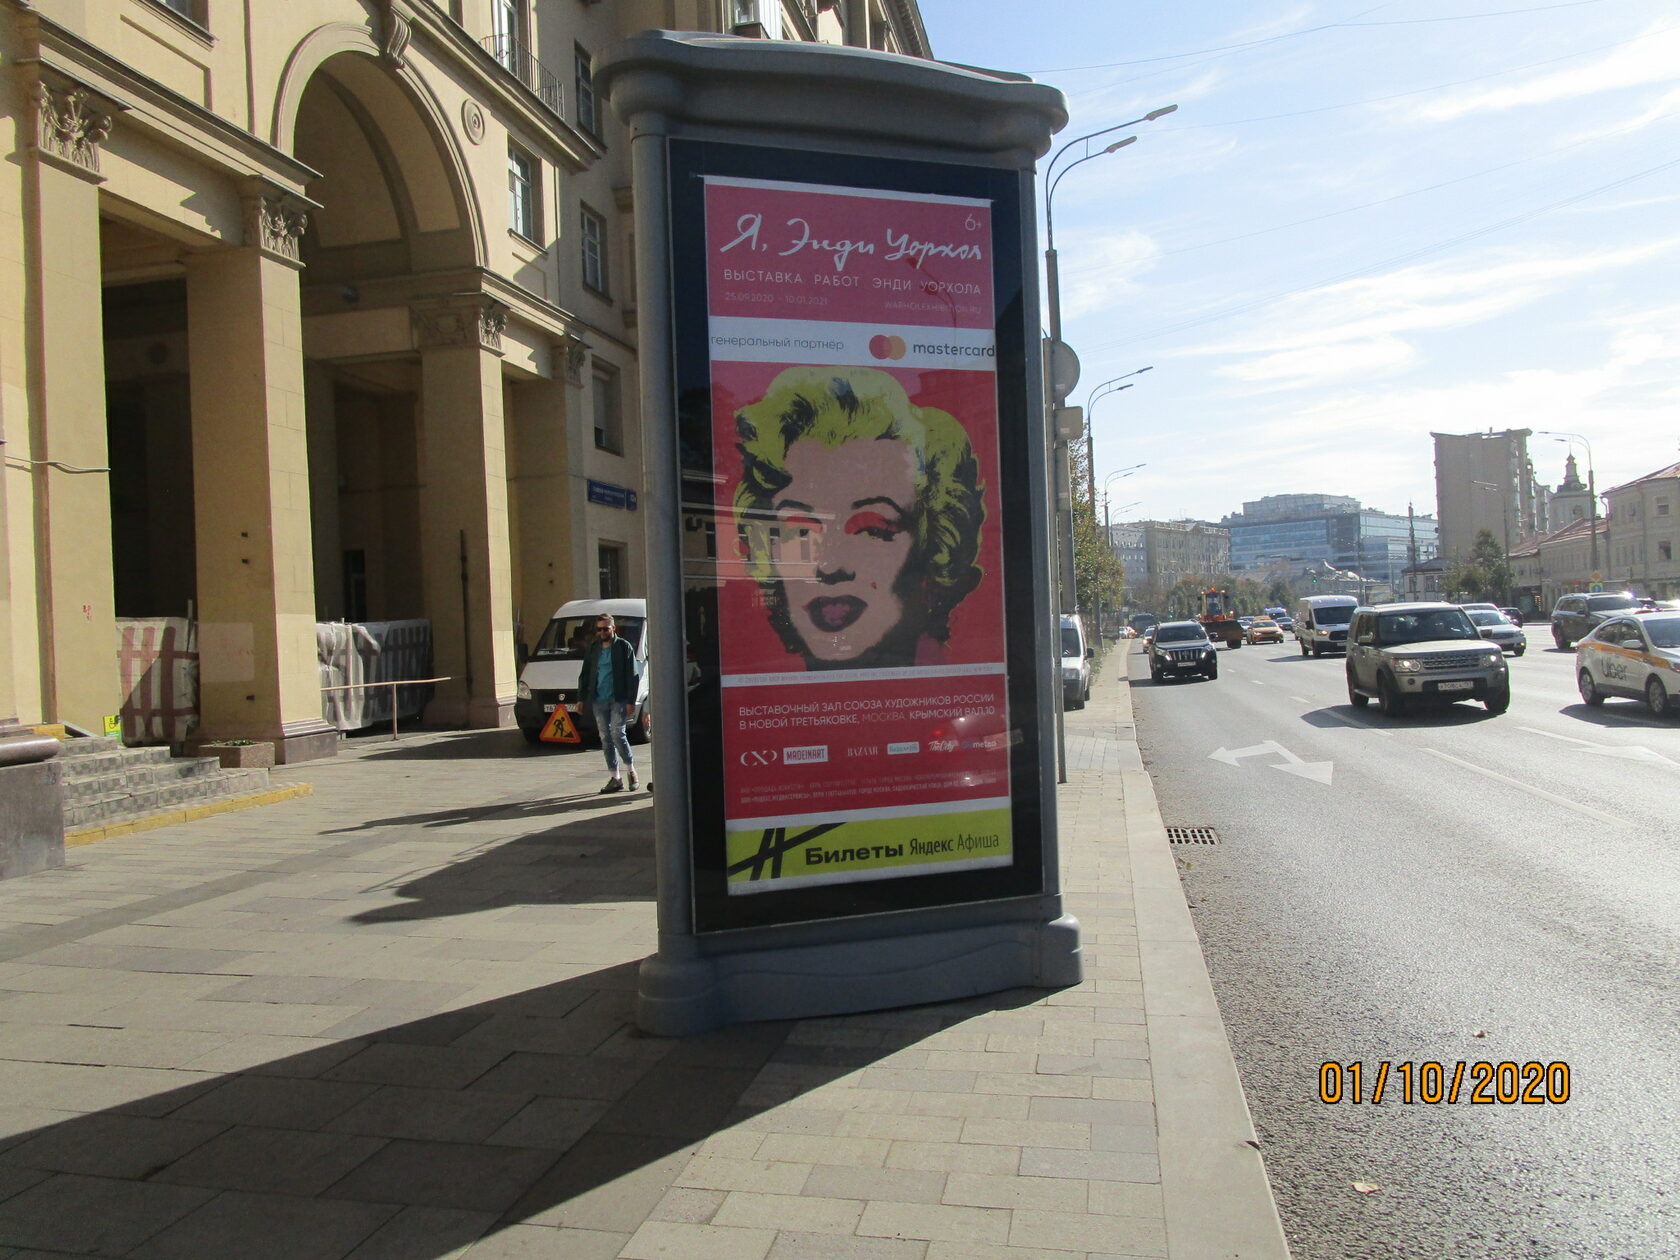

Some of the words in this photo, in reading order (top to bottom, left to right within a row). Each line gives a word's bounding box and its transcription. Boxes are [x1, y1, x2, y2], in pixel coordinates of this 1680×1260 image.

[964, 213, 982, 231] 6+
[720, 213, 767, 253] Я,
[778, 217, 875, 272] Энди
[884, 228, 982, 270] Уорхол
[723, 268, 803, 284] ВЫСТАВКА
[814, 273, 860, 287] РАБОТ
[872, 276, 912, 291] ЭНДИ
[920, 281, 981, 295] УОРХОЛА
[710, 335, 791, 349] генеральный
[912, 342, 996, 358] mastercard
[739, 701, 819, 717] ВЫСТАВОЧНЫЙ
[821, 701, 842, 713] ЗАЛ
[844, 698, 882, 711] СОЮЗА
[884, 695, 951, 710] ХУДОЖНИКОВ
[953, 692, 995, 705] РОССИИ
[739, 720, 747, 730] В
[749, 716, 788, 730] НОВОЙ
[790, 713, 860, 728] ТРЕТЬЯКОВКЕ,
[909, 706, 963, 721] КРЫМСКИЙ
[786, 748, 826, 761] MADEINART
[847, 746, 879, 758] BAZAAR
[805, 845, 904, 865] Билеты
[910, 838, 955, 856] Яндекс
[957, 833, 1000, 850] Афиша
